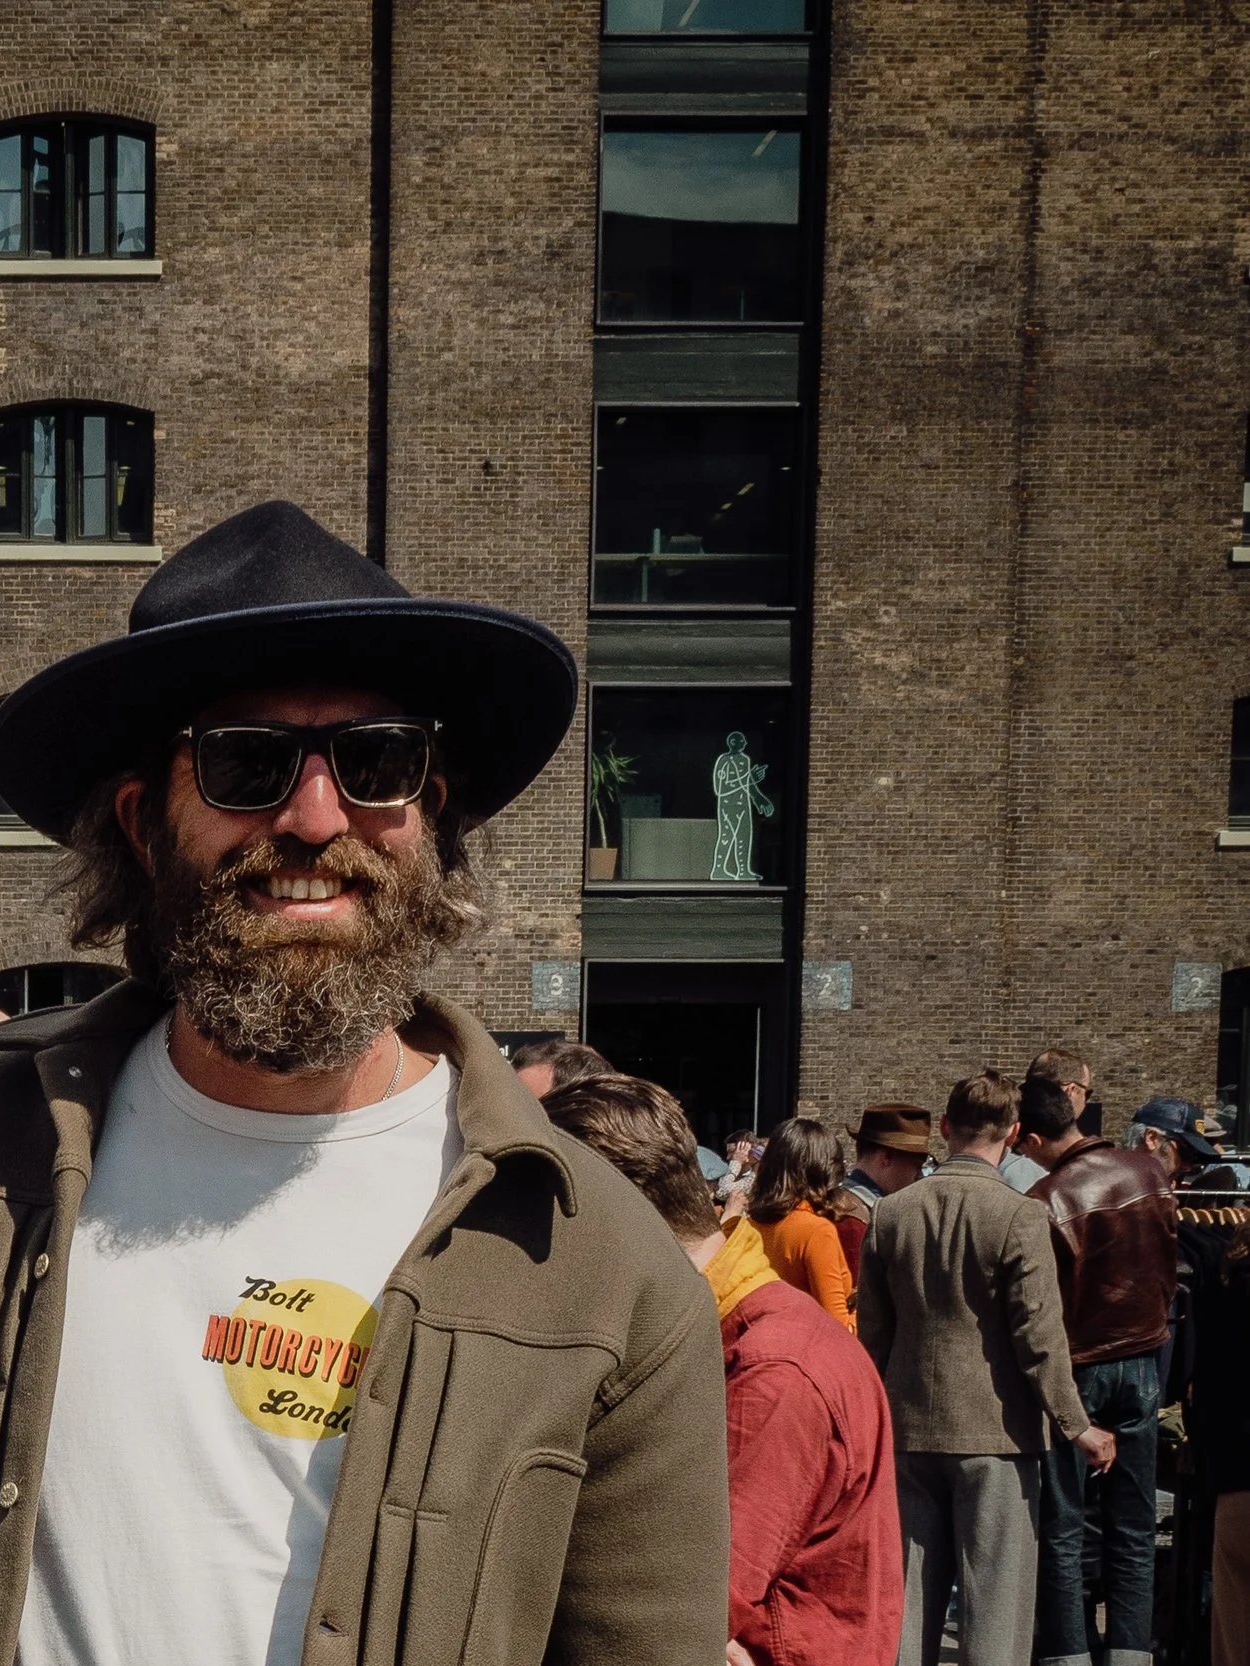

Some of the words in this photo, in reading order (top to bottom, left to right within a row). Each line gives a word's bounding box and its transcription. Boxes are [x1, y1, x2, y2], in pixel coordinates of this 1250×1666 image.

[550, 974, 563, 996] 3
[818, 973, 832, 996] 2
[237, 1275, 316, 1314] Bolt
